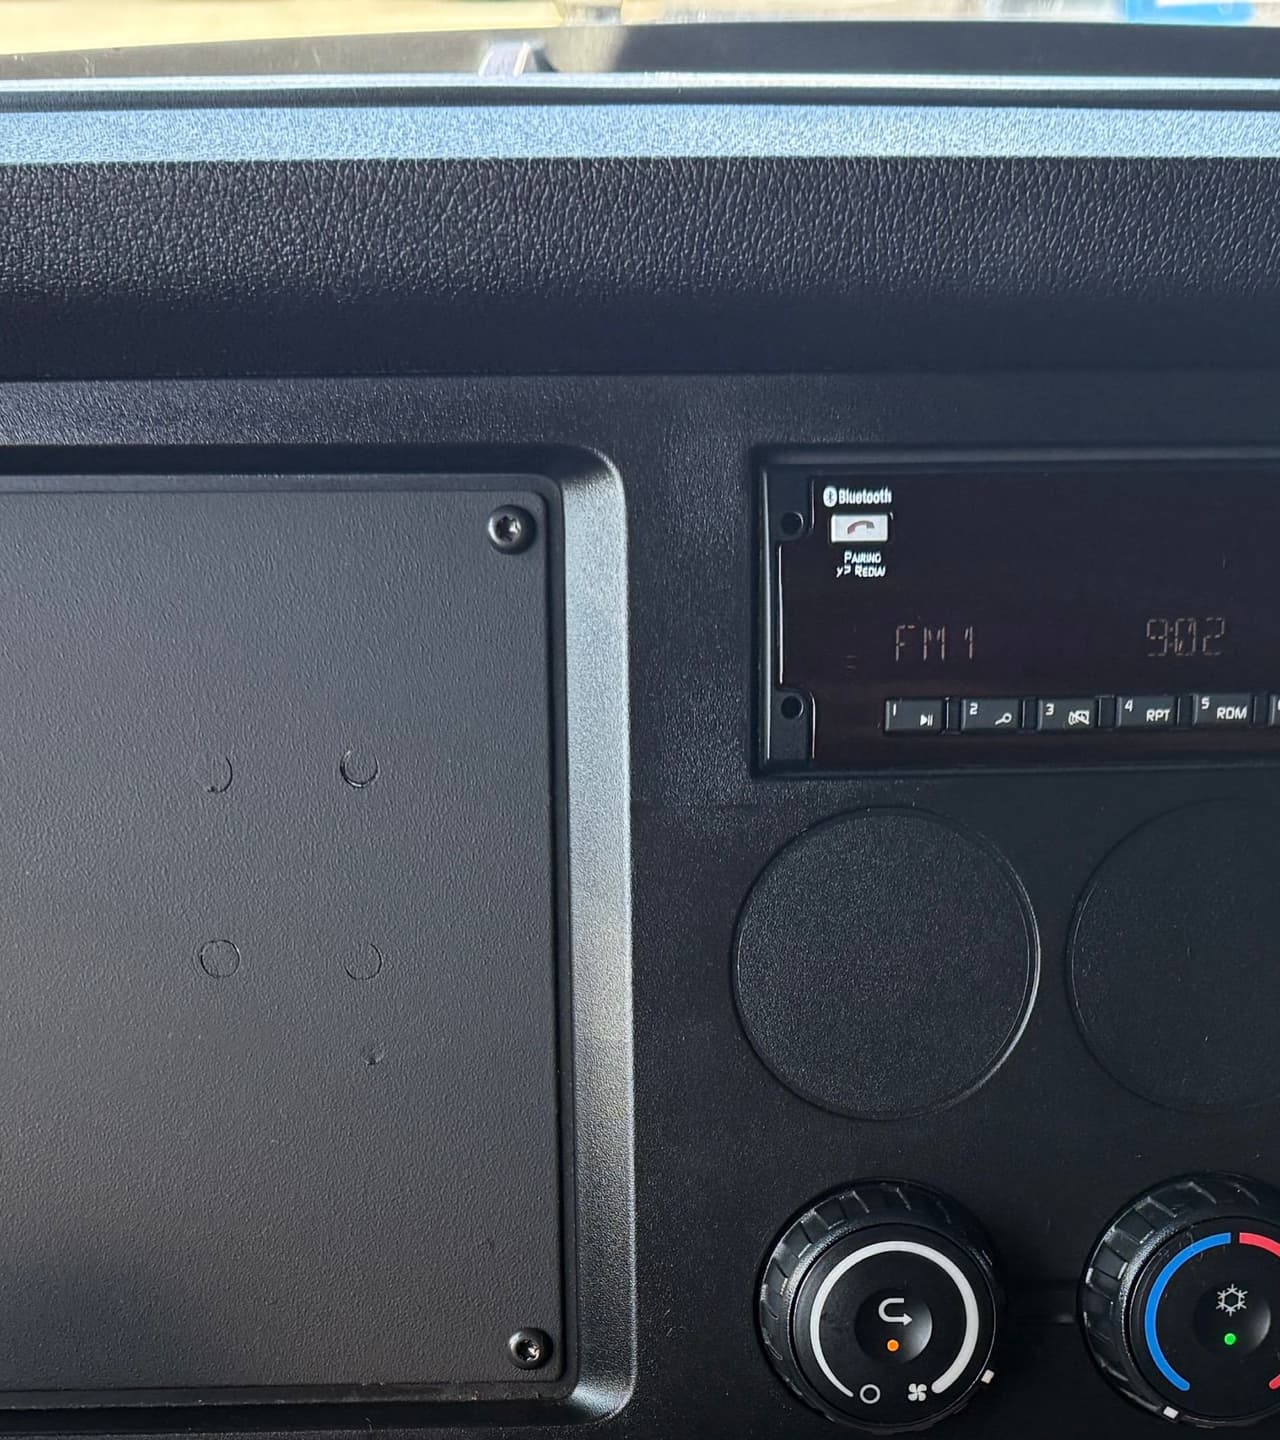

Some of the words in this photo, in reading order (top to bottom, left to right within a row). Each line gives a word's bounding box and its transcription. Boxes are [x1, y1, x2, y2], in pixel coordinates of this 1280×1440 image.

[839, 487, 892, 504] Bluetooth
[1146, 617, 1225, 656] 9:02
[969, 702, 979, 715] 2
[1044, 703, 1055, 716] 3
[1124, 700, 1134, 712] 4
[1146, 708, 1171, 722] RPT
[1201, 697, 1210, 710] 5
[1216, 706, 1248, 720] RDM
